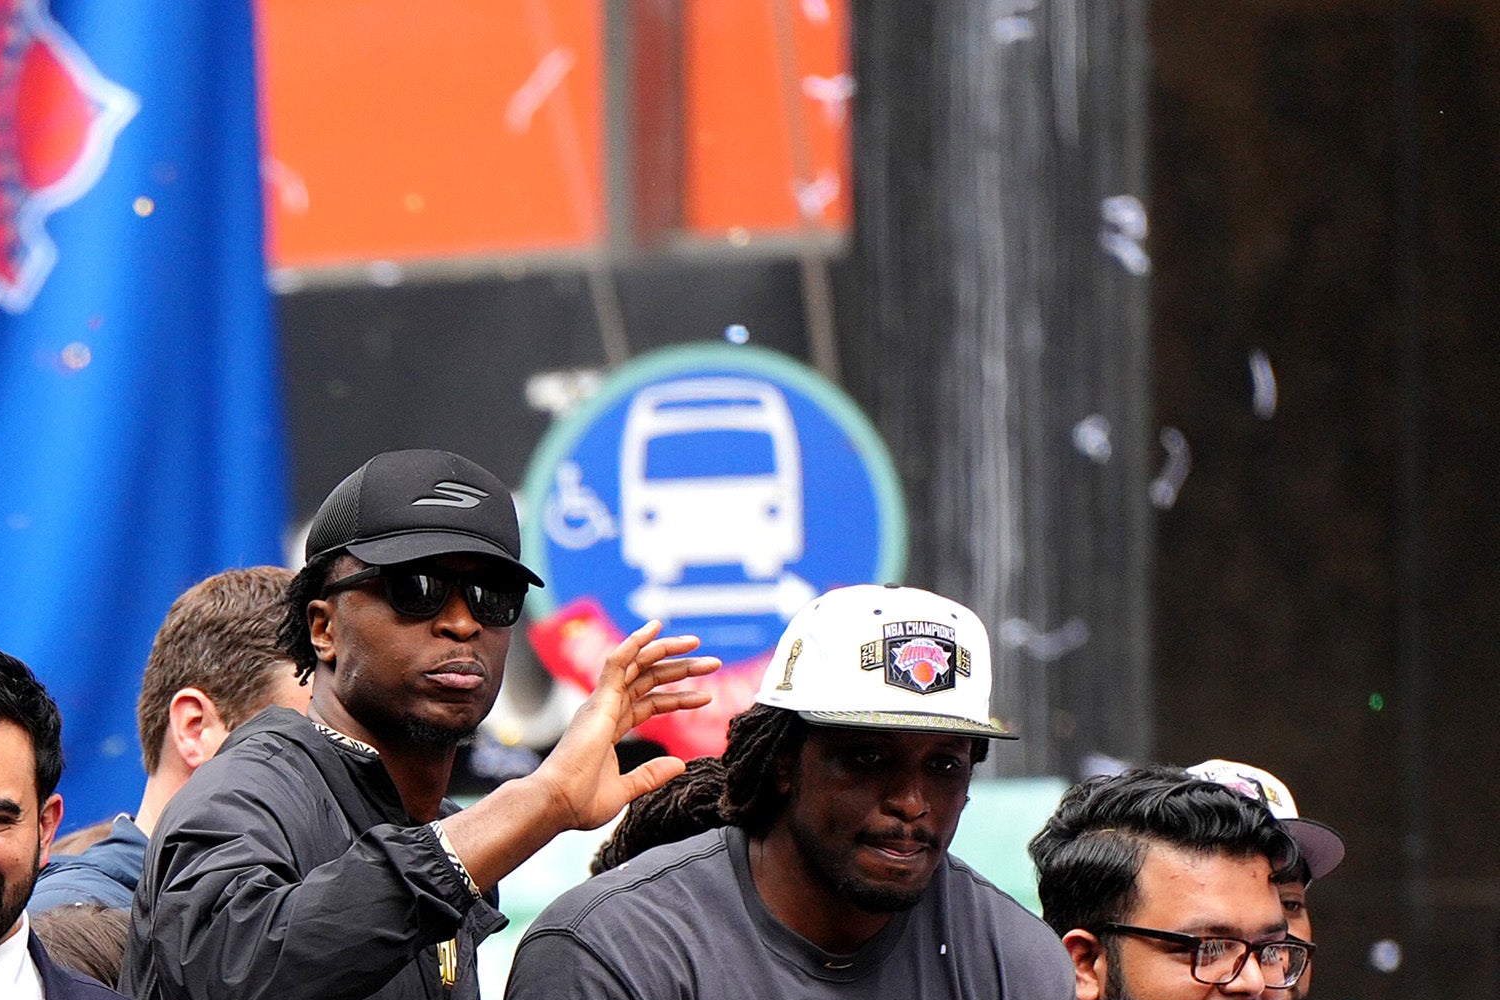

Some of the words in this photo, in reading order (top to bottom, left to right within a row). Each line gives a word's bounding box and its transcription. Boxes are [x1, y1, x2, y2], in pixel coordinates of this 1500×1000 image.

[884, 623, 904, 638] NBA
[906, 622, 955, 639] CHAMPIONS
[862, 644, 874, 656] 20
[862, 655, 874, 666] 25
